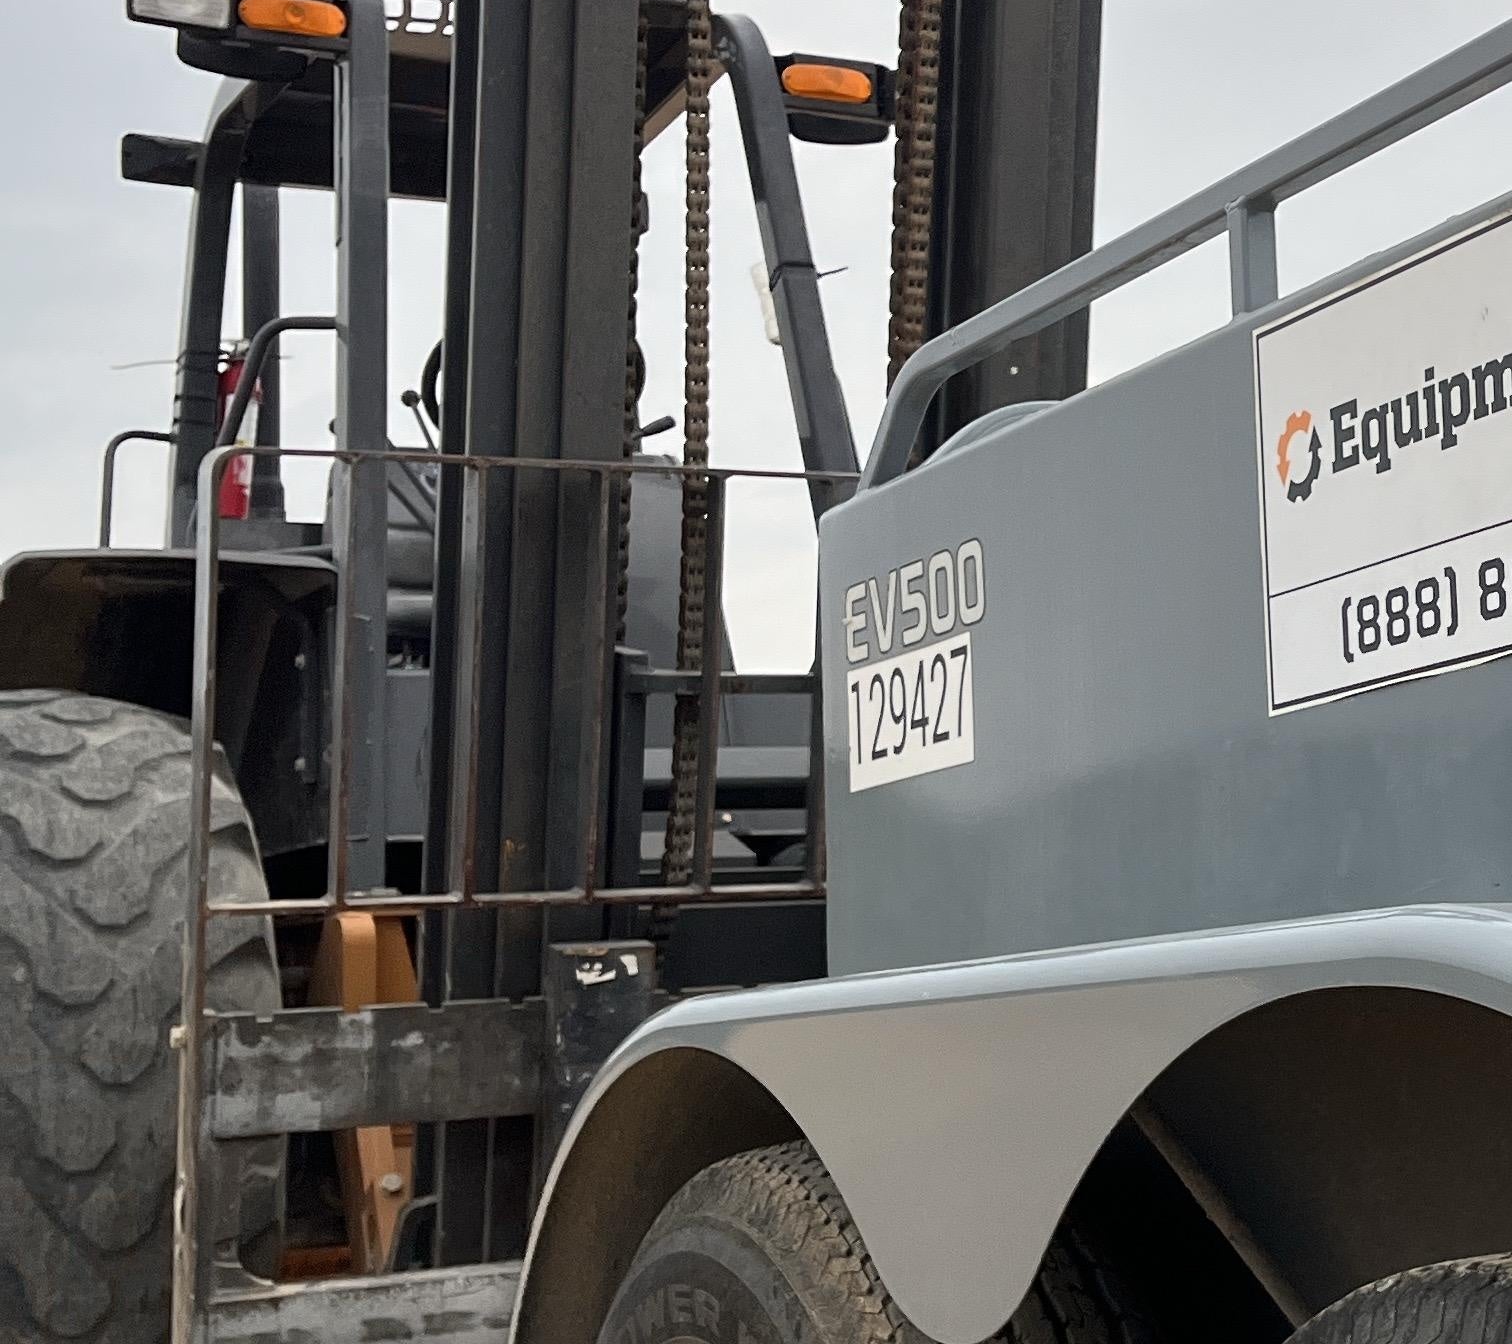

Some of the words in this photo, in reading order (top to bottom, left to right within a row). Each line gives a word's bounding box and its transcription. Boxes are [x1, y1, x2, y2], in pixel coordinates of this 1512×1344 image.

[844, 538, 985, 664] EV500
[1341, 566, 1459, 663] (888)
[851, 645, 968, 765] 129427
